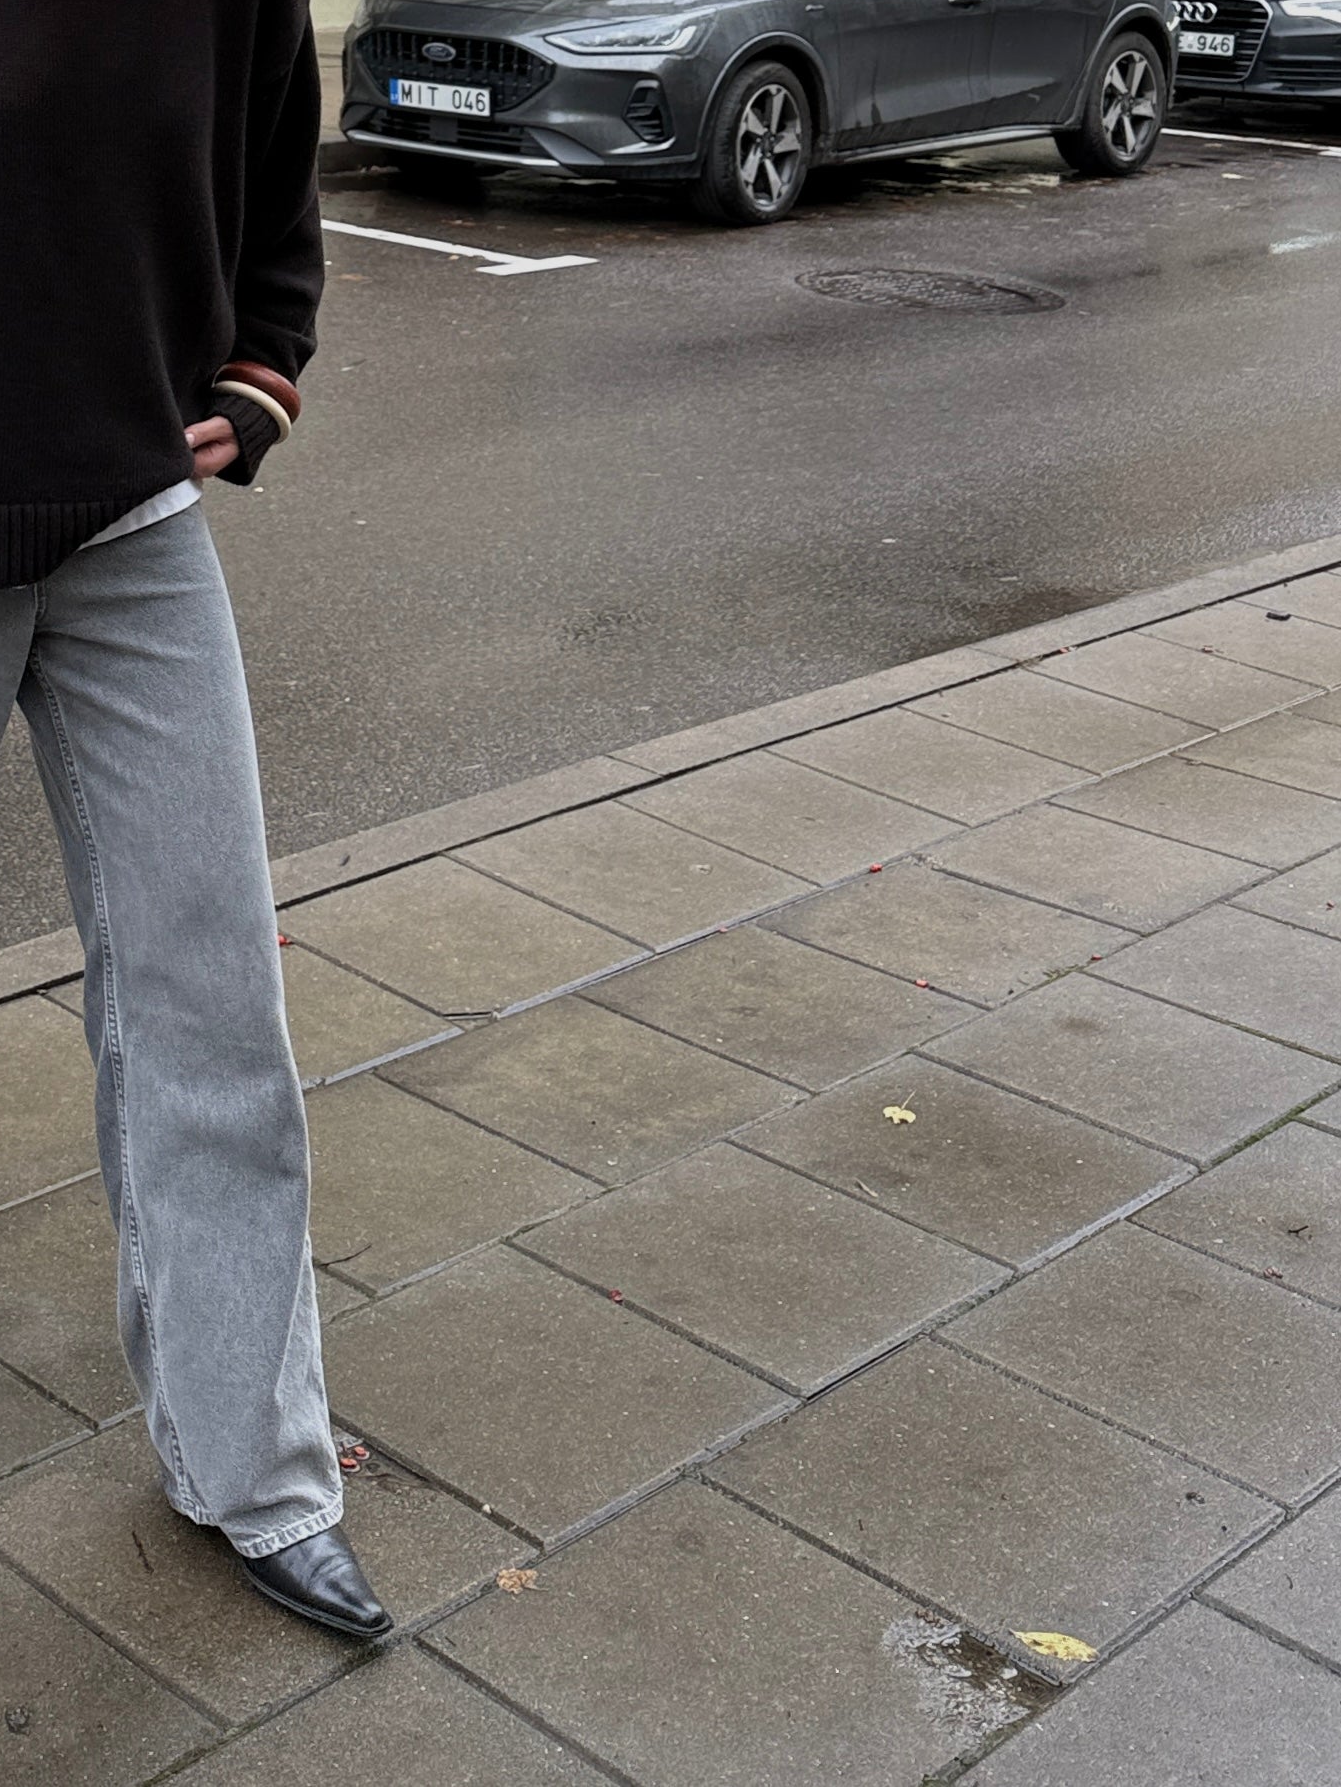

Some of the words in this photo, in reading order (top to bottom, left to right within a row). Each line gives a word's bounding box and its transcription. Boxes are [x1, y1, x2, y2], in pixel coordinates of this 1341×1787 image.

[1198, 35, 1231, 53] 946
[402, 83, 439, 106] MIT
[452, 90, 486, 112] 046
